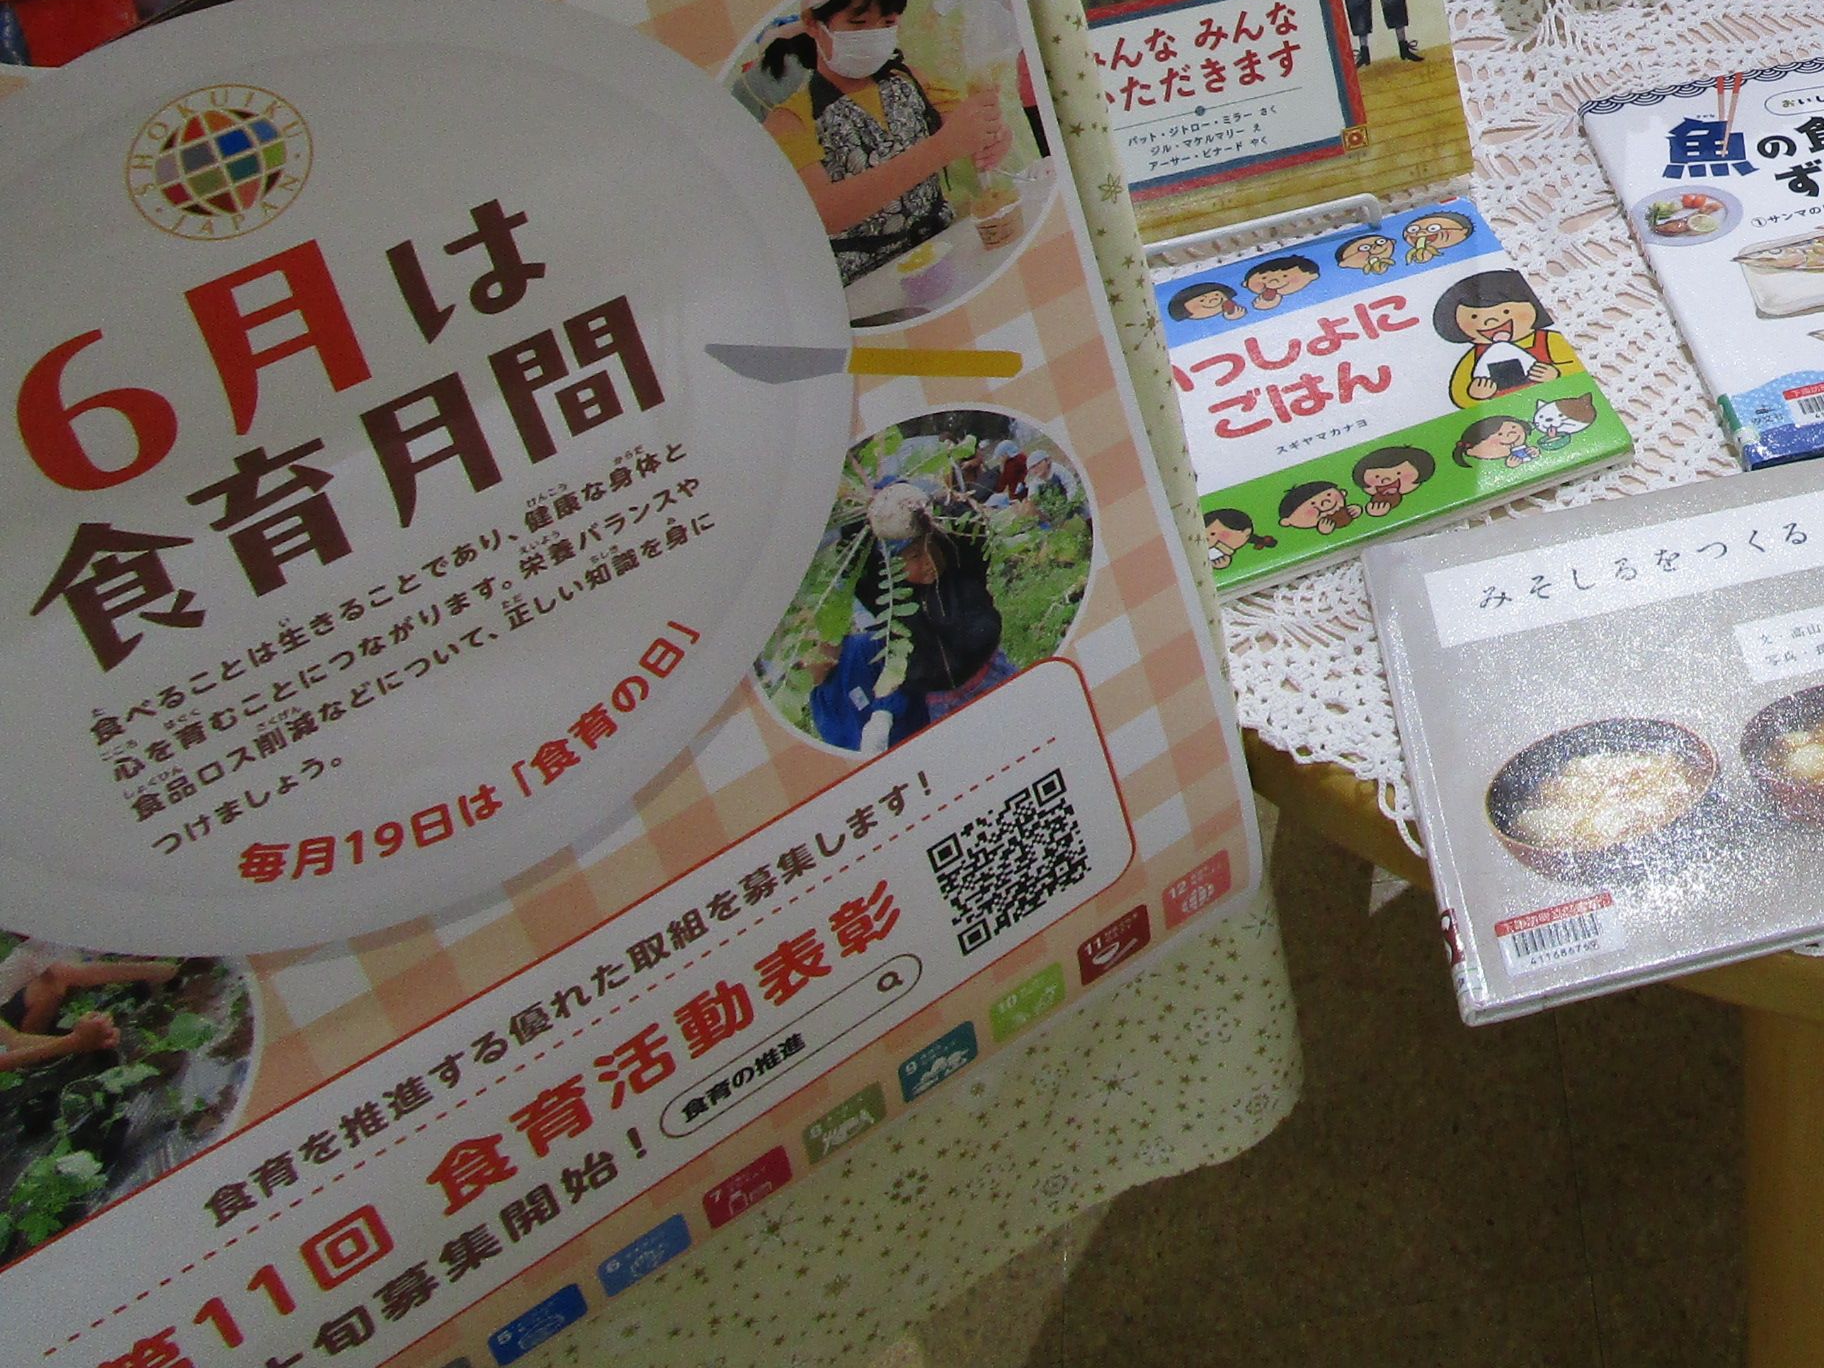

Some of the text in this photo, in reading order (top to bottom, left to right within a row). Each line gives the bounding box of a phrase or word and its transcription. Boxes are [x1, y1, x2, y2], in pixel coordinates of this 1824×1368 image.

[1093, 1, 1299, 74] んな みんな
[17, 198, 546, 492] 6月は
[30, 295, 666, 673] 食育月間
[1208, 361, 1392, 438] ごはん
[1276, 419, 1369, 454] スギヤマカナヨ
[90, 443, 687, 745] 食べることは生きることであり、健康な身体と
[113, 478, 700, 782] 心を育むことにつながります。栄養バランスや
[131, 513, 715, 822] 食品ロス削減などについて、正しい知識を身に
[1478, 520, 1811, 611] みそしるをつくる
[152, 756, 342, 855] つけましょう。
[238, 618, 701, 884] 毎月19日は「食育の日」
[203, 771, 932, 1229] 食育を推進する優れた取組を募集します！
[425, 880, 904, 1217] 食育活動表彰
[681, 1032, 806, 1123] 食育の推進
